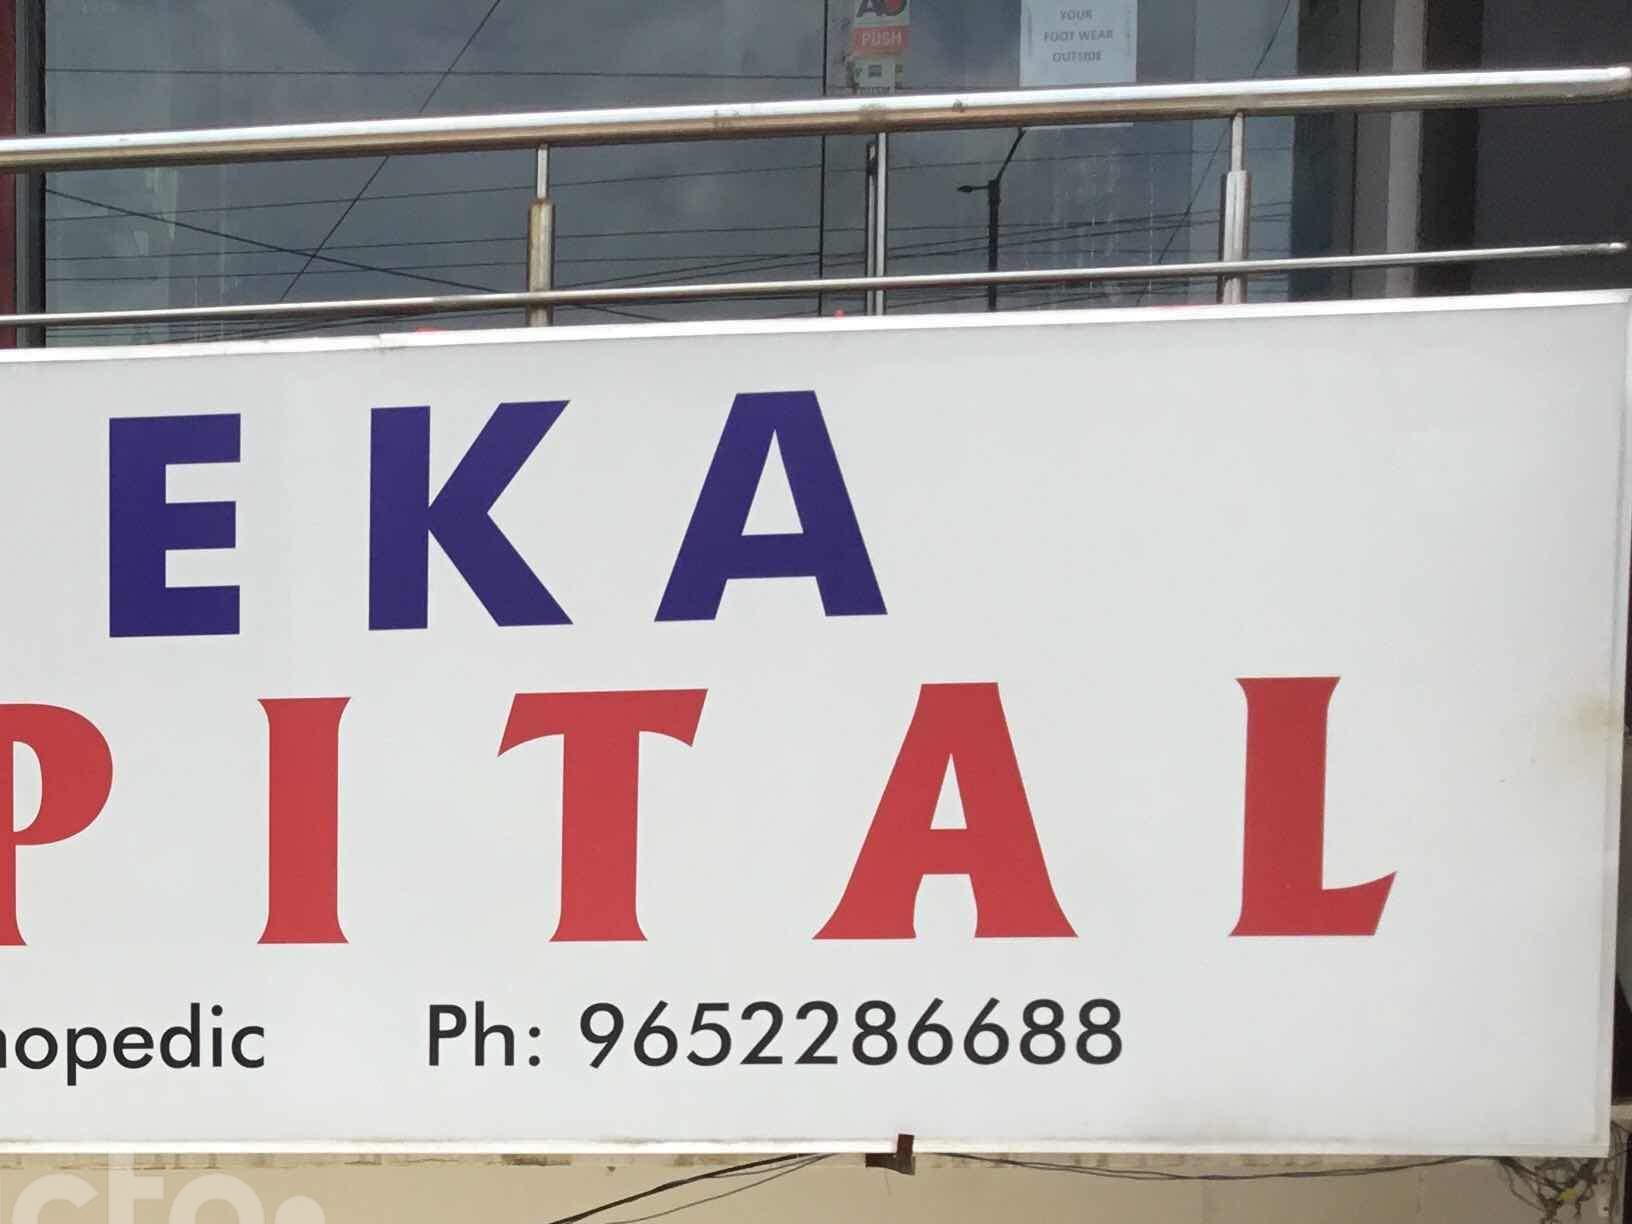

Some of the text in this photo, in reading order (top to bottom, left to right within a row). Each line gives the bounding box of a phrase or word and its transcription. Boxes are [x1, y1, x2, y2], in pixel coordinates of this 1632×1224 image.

[1059, 9, 1093, 21] YOUR
[861, 31, 903, 47] PUSH
[1052, 51, 1102, 62] OUTSIDE
[430, 1001, 542, 1068] Ph:
[581, 998, 1123, 1070] 9652286688
